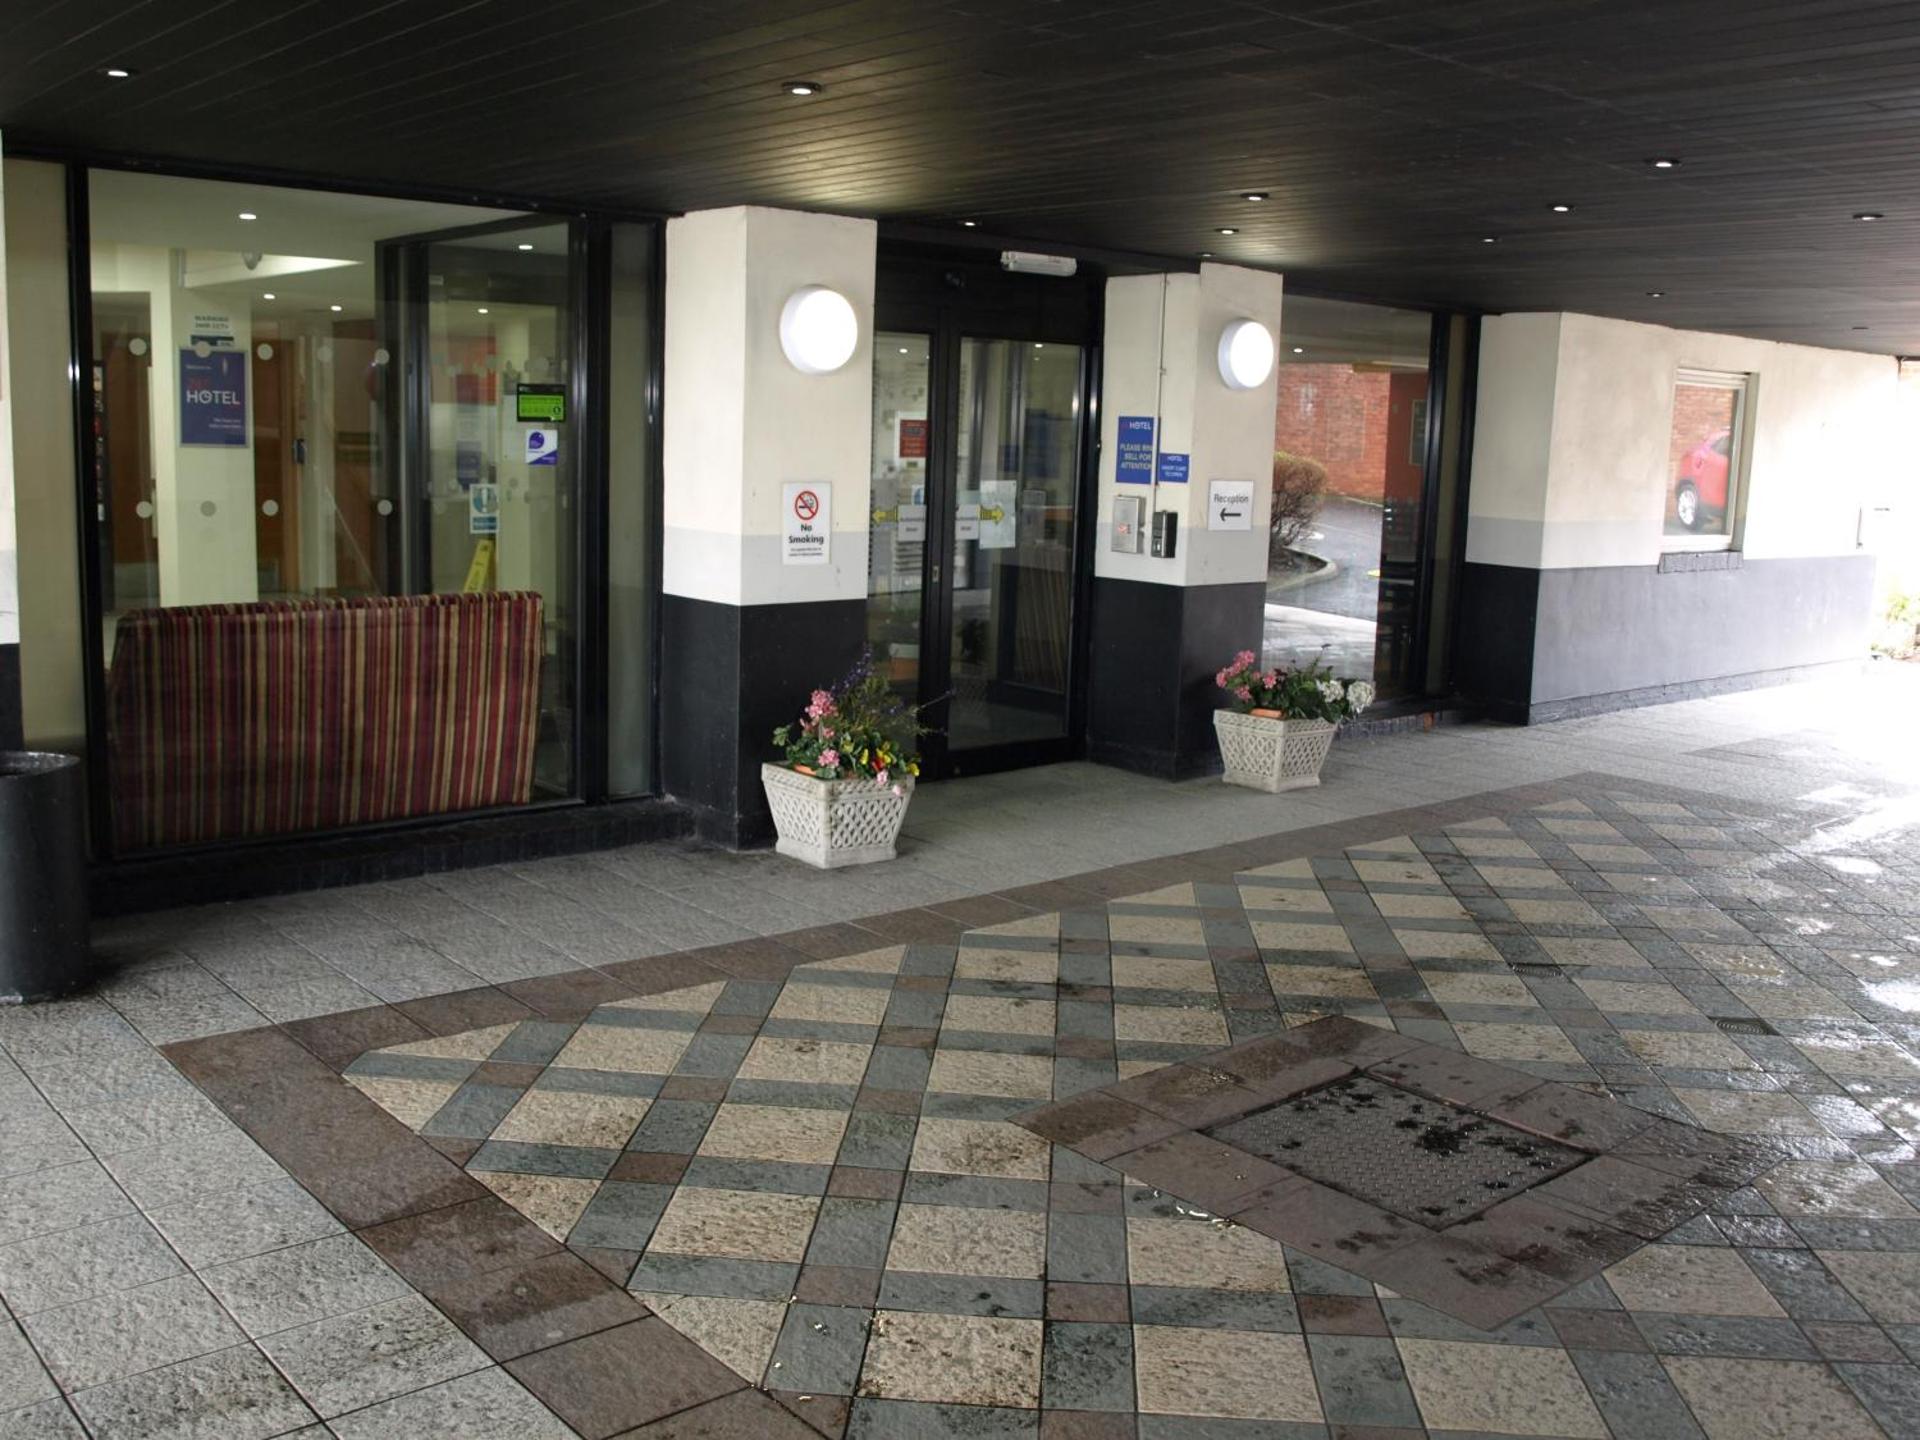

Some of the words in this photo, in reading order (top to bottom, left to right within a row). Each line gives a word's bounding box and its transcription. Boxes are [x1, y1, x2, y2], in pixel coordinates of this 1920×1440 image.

[186, 389, 241, 405] HOTEL
[1129, 421, 1152, 430] HOTEL
[1120, 444, 1140, 452] PLEASE
[1213, 493, 1249, 504] Reception
[800, 524, 812, 532] No
[788, 535, 824, 545] Smoking
